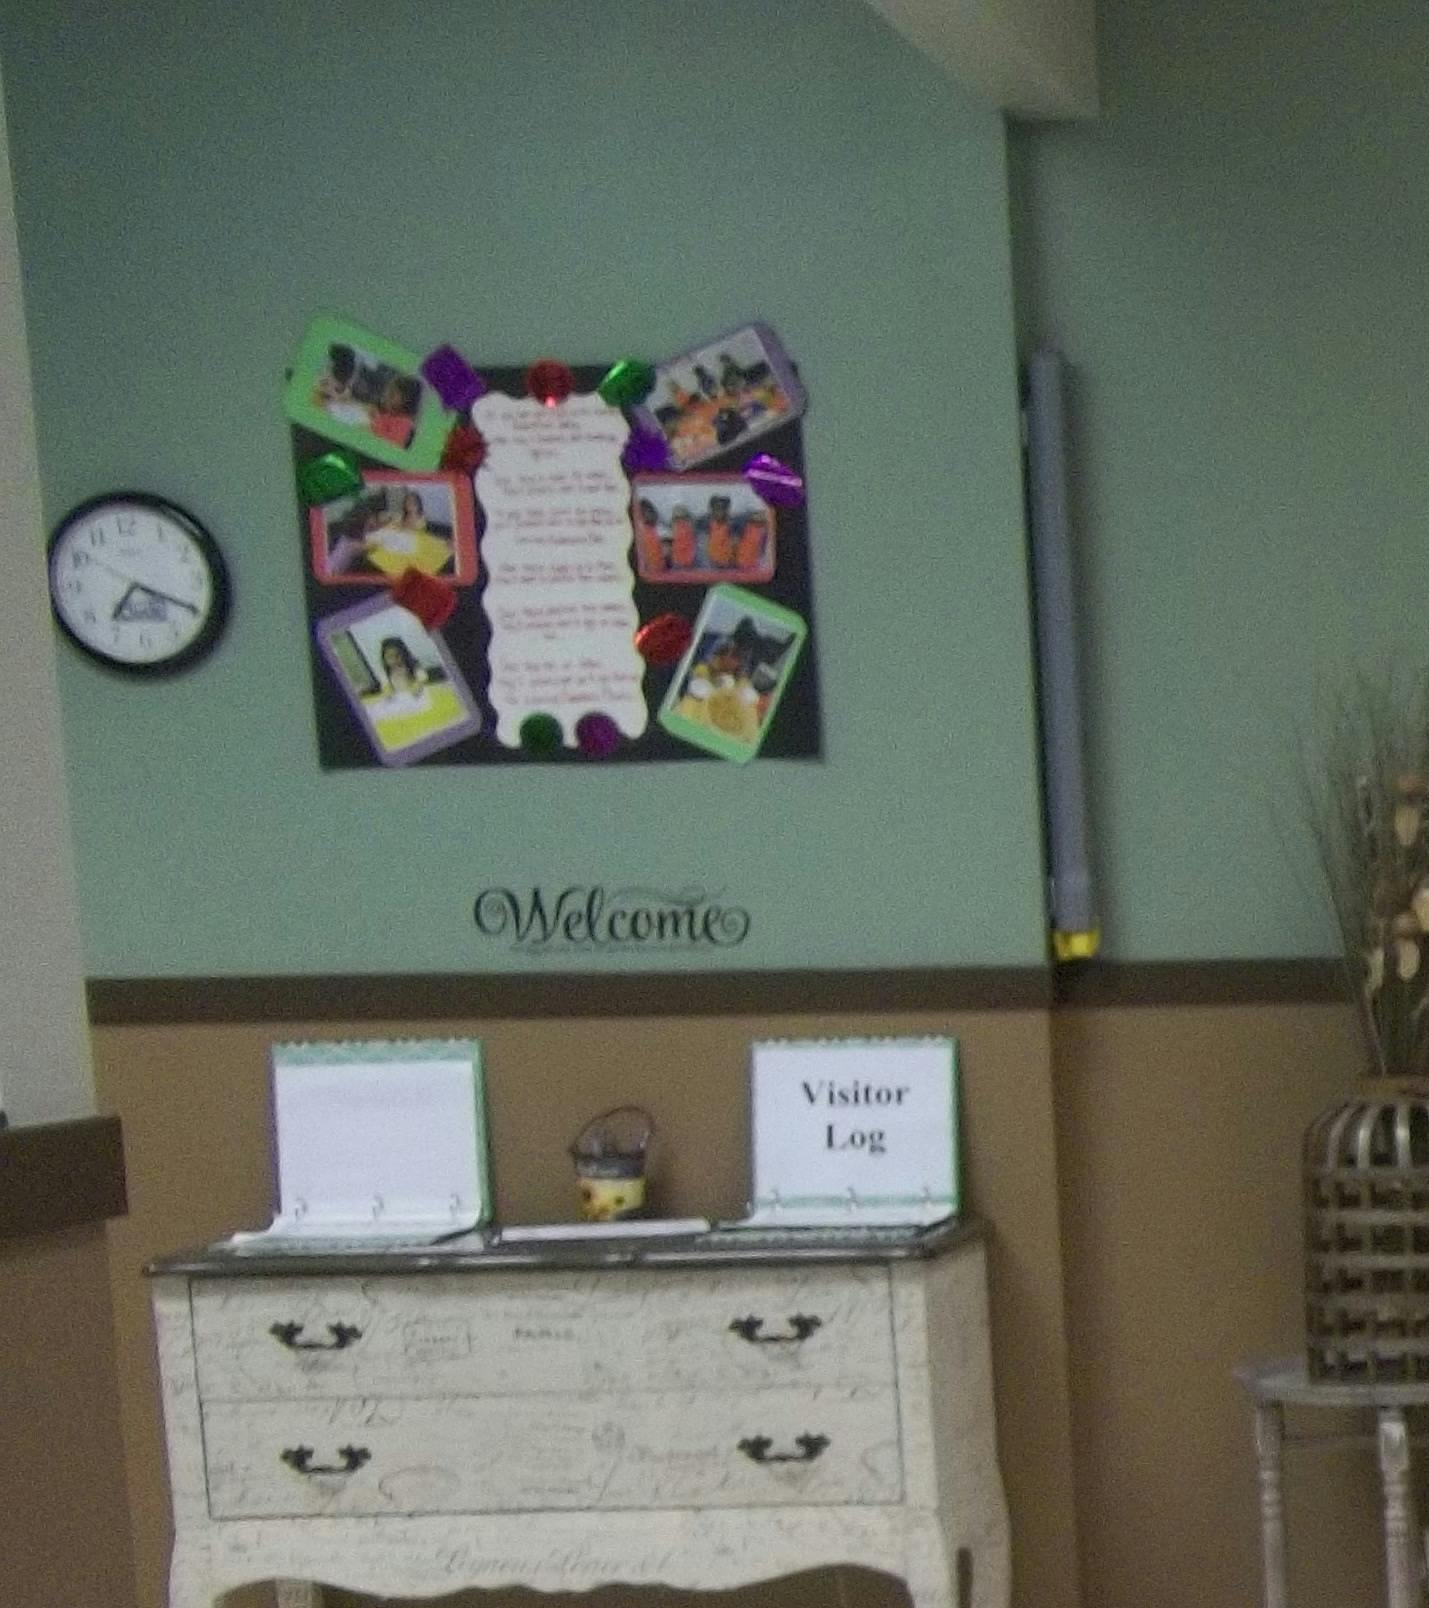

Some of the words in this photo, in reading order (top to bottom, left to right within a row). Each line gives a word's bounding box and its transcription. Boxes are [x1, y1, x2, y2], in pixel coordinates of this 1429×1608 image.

[473, 884, 752, 948] Welcome
[801, 1080, 911, 1106] Visitor
[826, 1123, 887, 1154] Log
